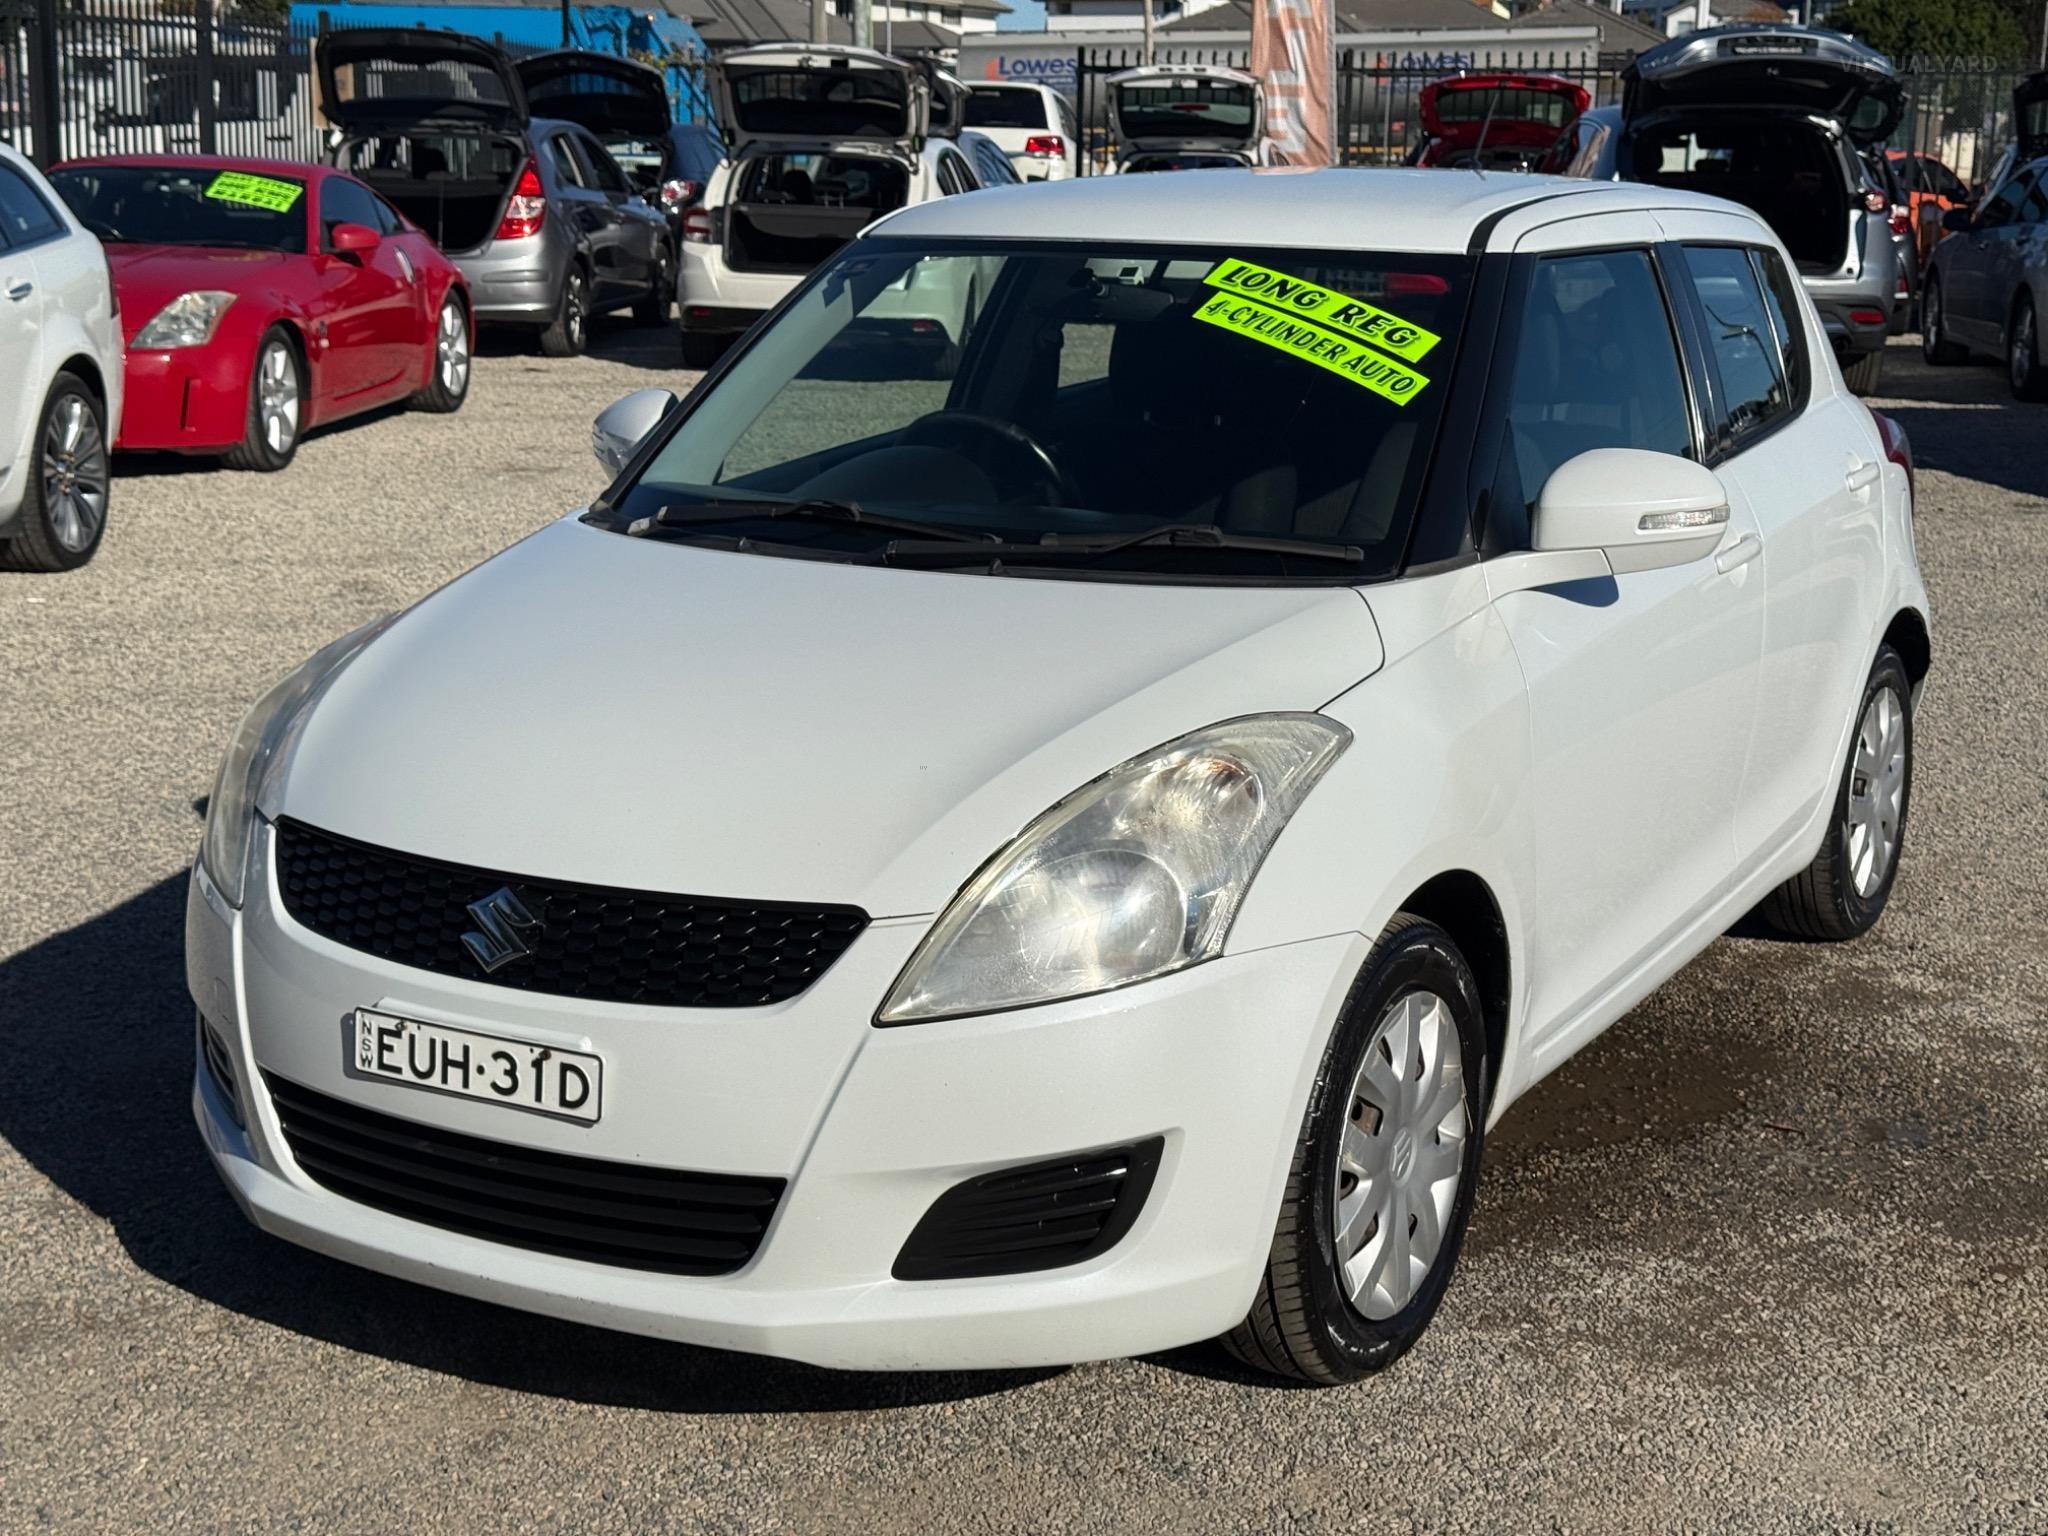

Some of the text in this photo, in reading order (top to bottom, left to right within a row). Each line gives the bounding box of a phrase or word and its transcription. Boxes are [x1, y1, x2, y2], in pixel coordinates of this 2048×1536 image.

[999, 55, 1078, 75] Lowes
[1205, 299, 1417, 396] 4-CYLINDER AUTO
[1219, 264, 1422, 349] LONG REG
